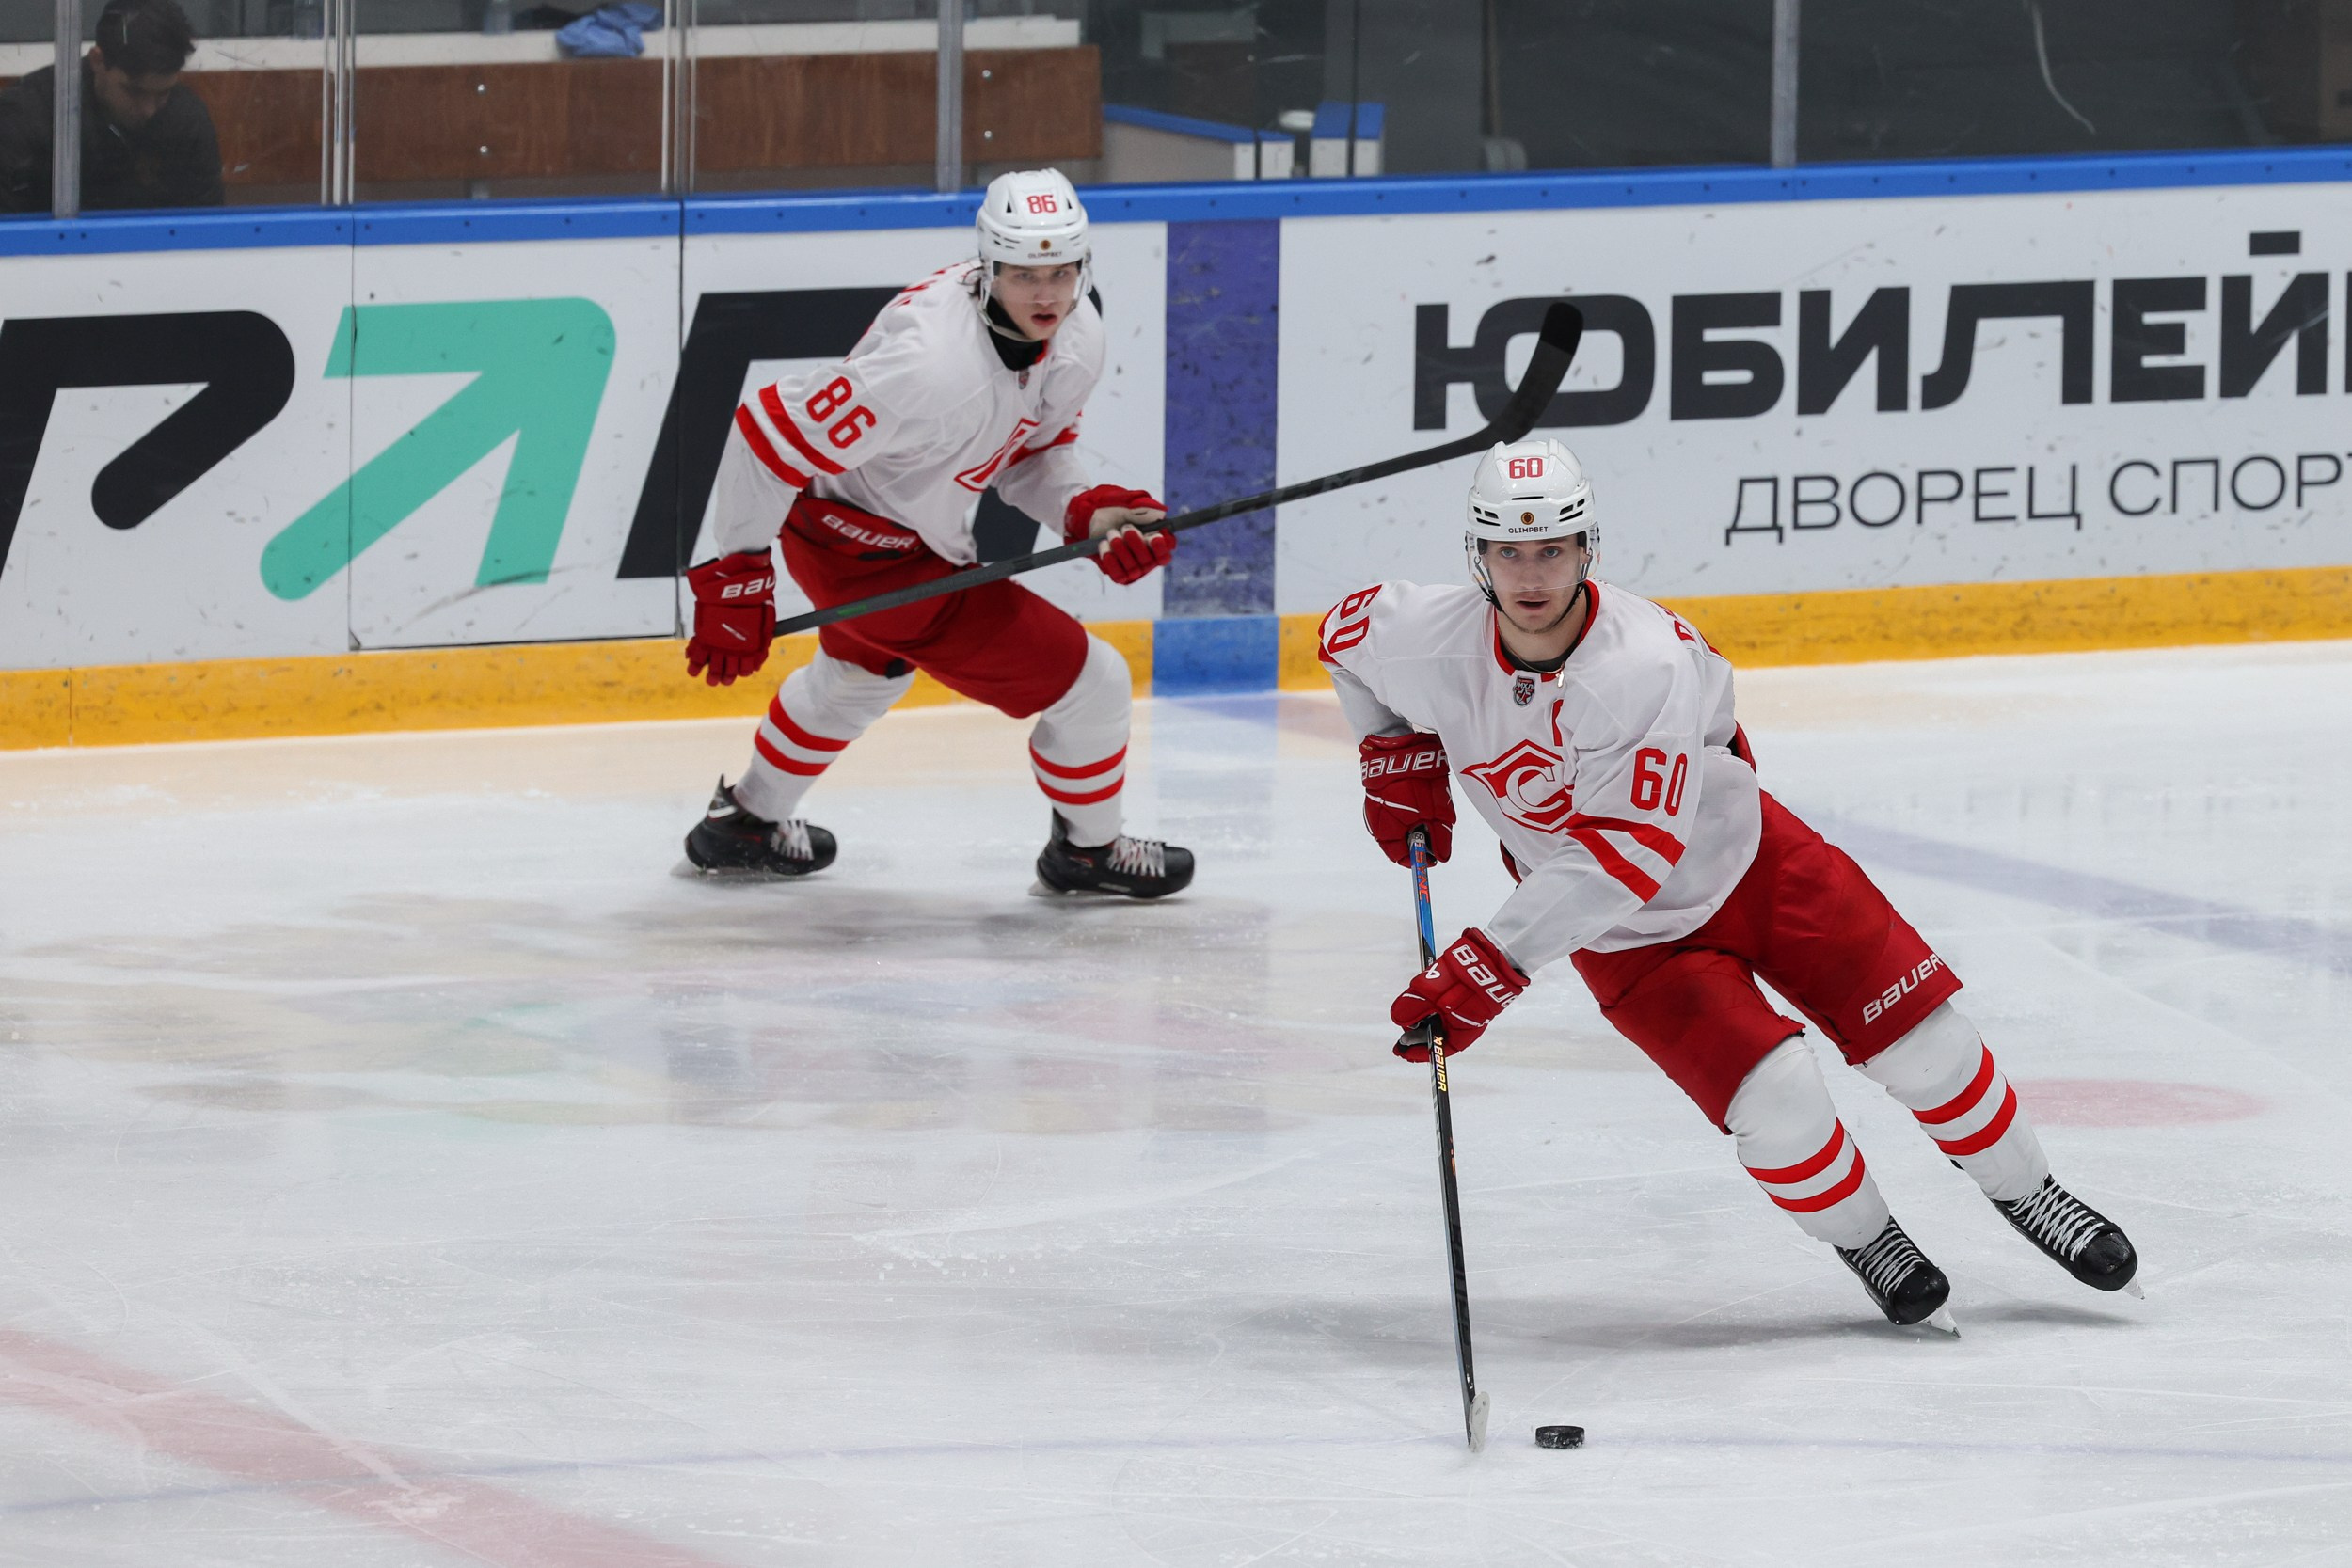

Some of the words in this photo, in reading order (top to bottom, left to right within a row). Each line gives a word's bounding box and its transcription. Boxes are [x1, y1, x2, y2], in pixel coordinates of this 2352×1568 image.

[1026, 194, 1058, 214] 86
[1413, 231, 2352, 430] ЮБИЛЕЙ
[805, 375, 877, 449] 86
[1508, 457, 1544, 479] 60
[1724, 464, 2082, 546] ДВОРЕЦ
[2110, 451, 2352, 516] СПОР
[821, 514, 917, 549] BAUER
[1508, 526, 1549, 534] OLIMPBET
[1327, 583, 1383, 655] 60
[1630, 746, 1689, 817] 60
[1862, 952, 1945, 1025] BAUER
[1434, 1045, 1447, 1092] BAUER
